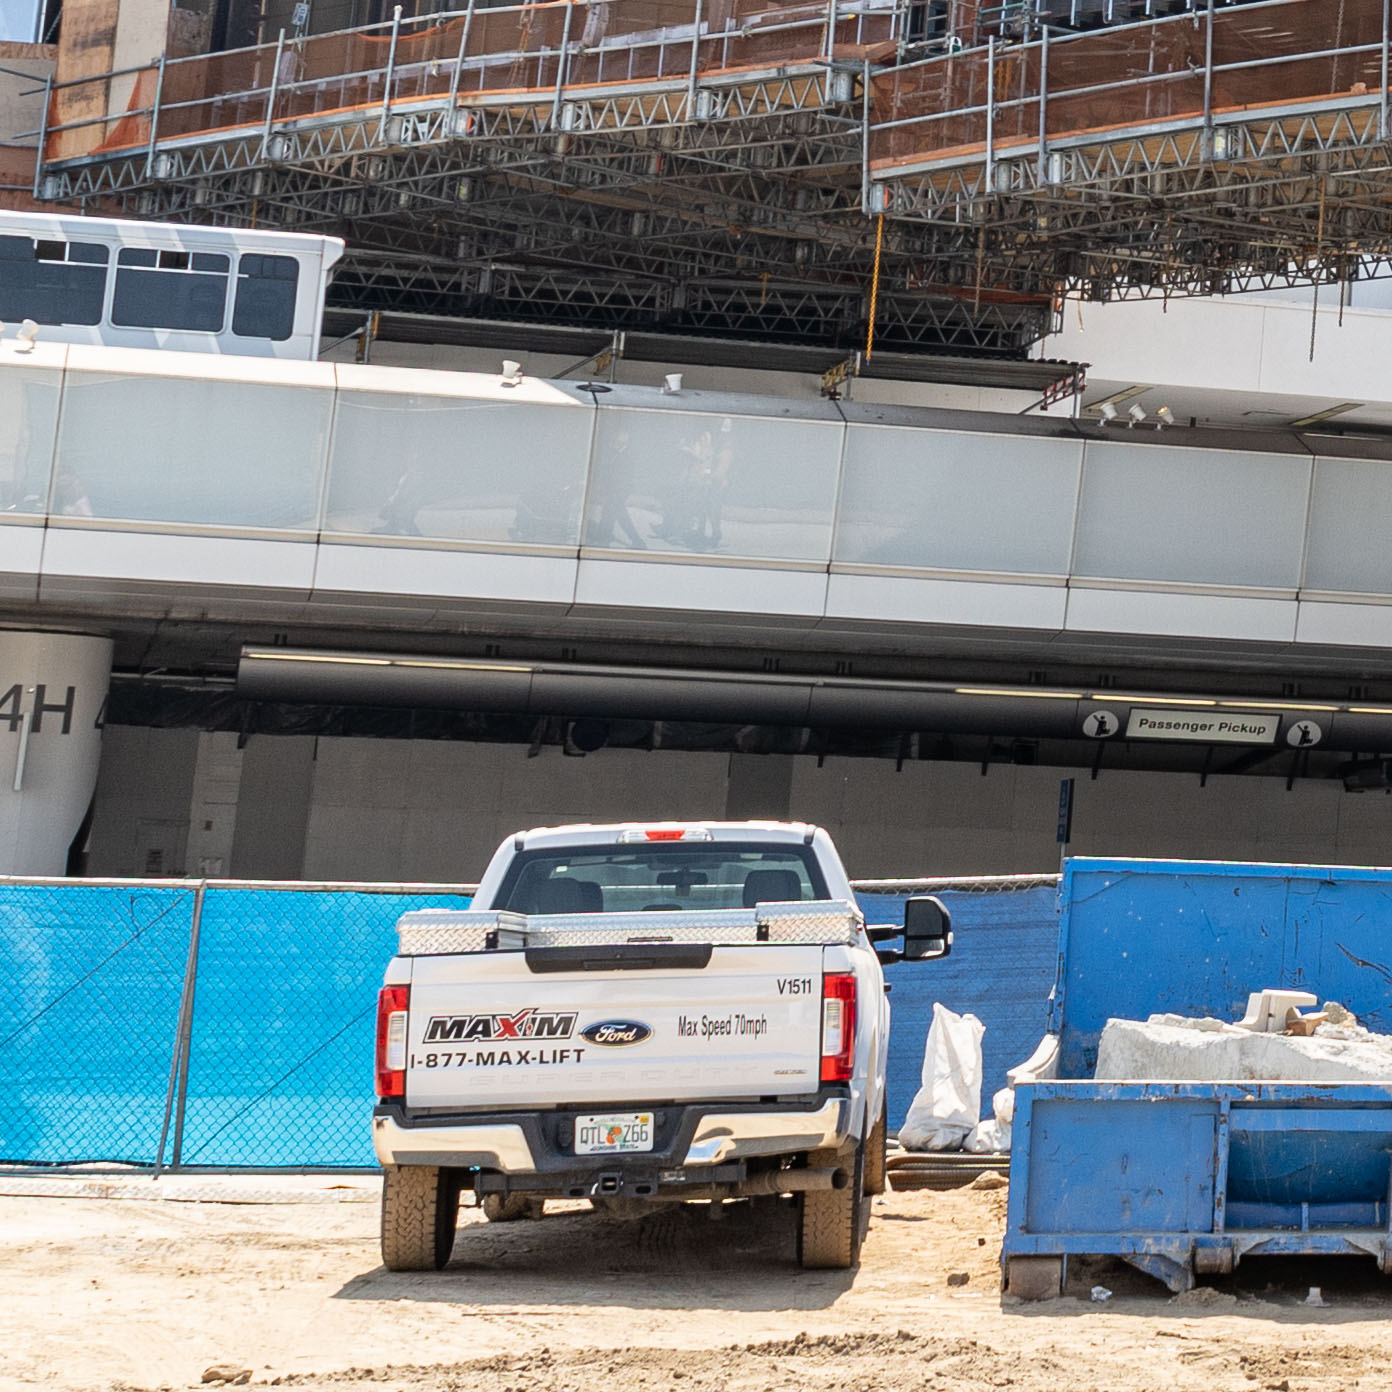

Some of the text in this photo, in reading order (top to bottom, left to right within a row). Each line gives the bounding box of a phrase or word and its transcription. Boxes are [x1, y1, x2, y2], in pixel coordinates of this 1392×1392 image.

[1138, 718, 1267, 735] Passenger Pickup
[777, 978, 812, 995] V1511
[422, 1007, 578, 1044] MAXIM
[594, 1019, 638, 1043] Ford
[678, 1014, 768, 1037] Max Speed 70mph
[410, 1048, 586, 1070] 1-877-MAX-LIFT
[580, 1123, 649, 1145] QTL Z66
